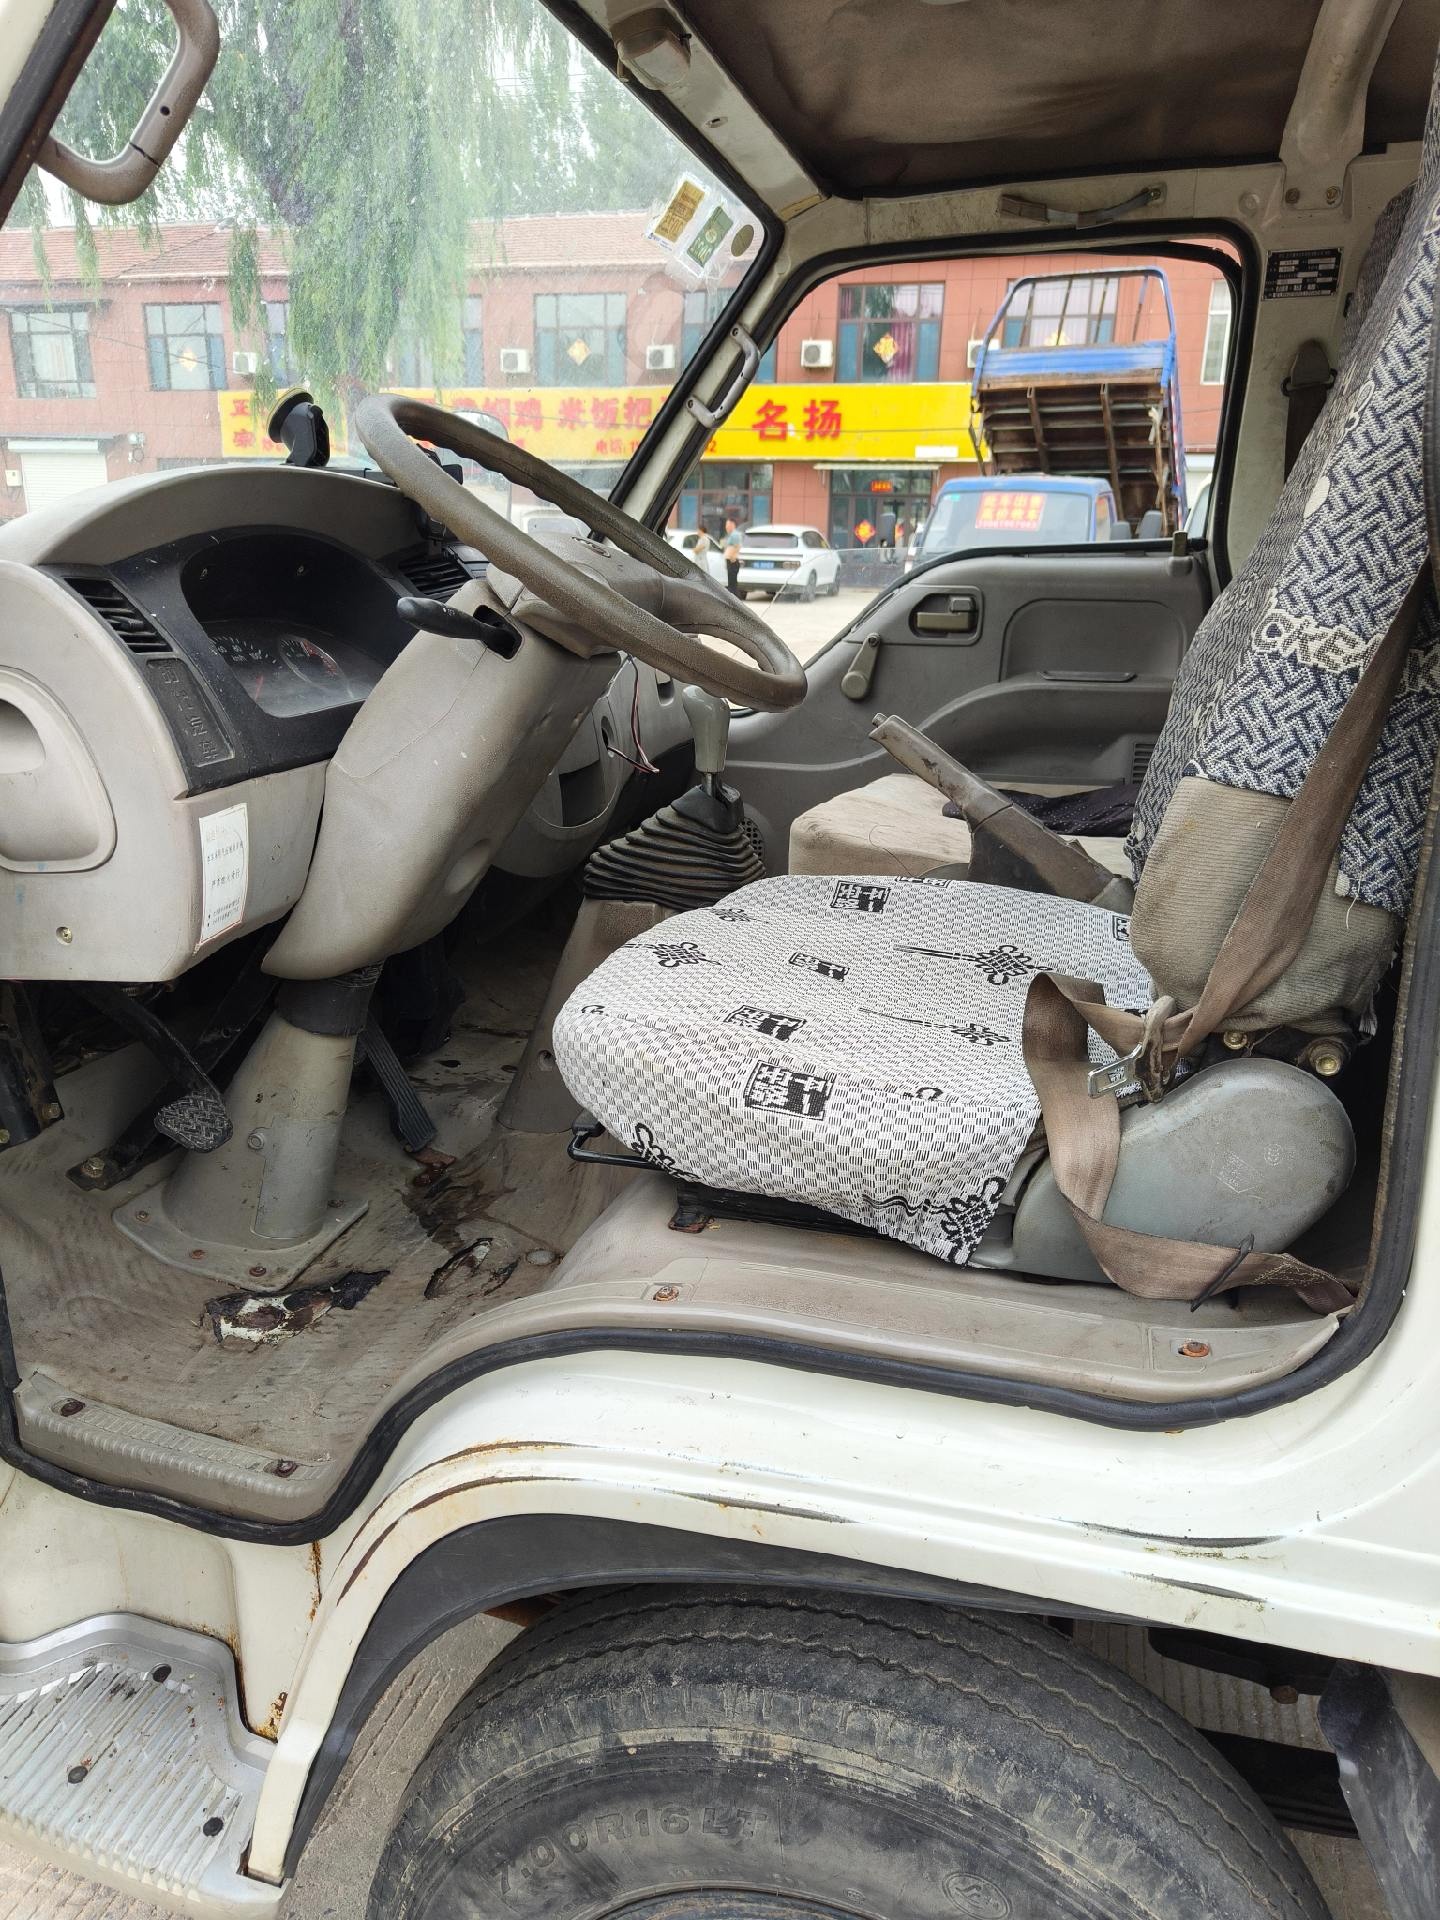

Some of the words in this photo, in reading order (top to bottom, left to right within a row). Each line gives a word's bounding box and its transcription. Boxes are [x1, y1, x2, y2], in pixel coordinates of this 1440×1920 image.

[558, 396, 668, 431] 米饭把
[752, 400, 842, 441] 名扬
